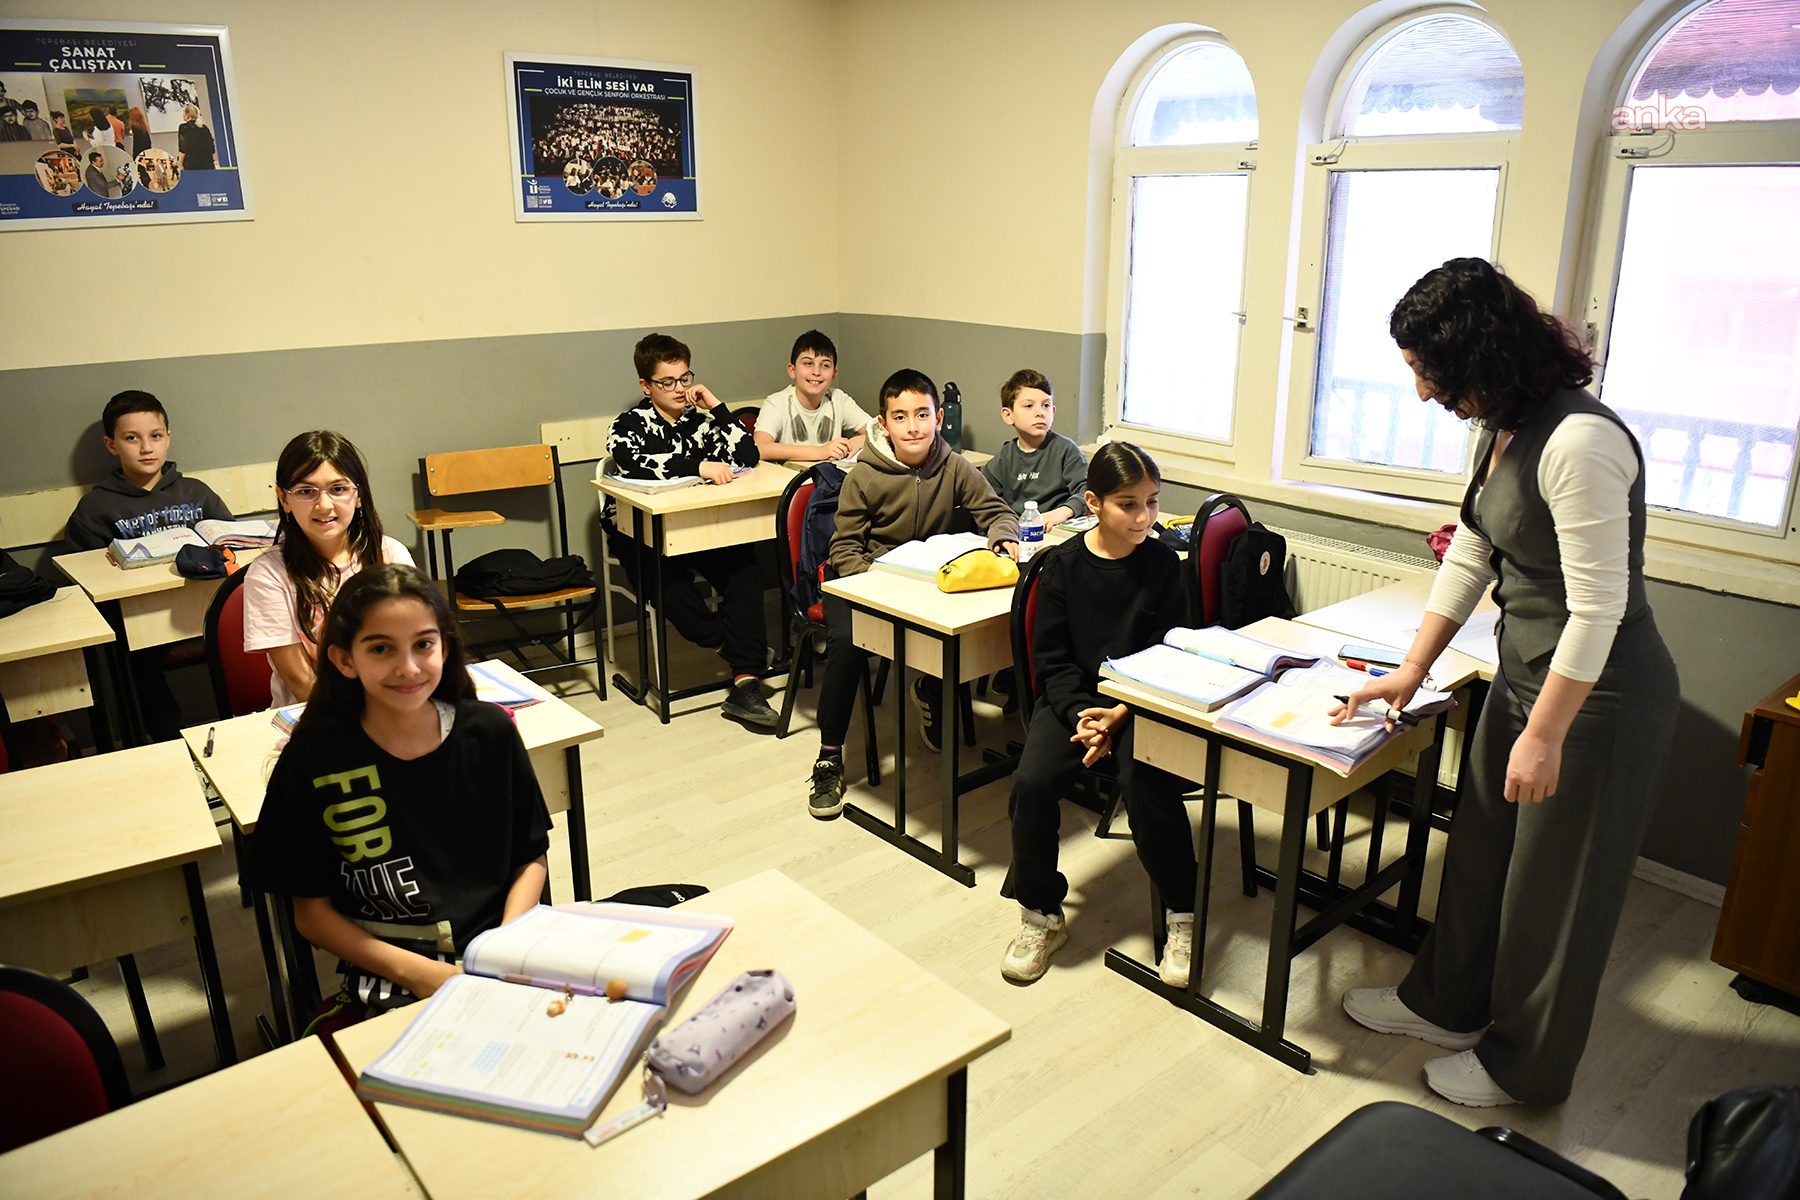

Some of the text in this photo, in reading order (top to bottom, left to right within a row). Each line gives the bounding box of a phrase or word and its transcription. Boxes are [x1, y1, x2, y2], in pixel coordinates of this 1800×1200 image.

[61, 46, 116, 58] SANAT
[48, 58, 133, 73] ÇALIŞTAYI
[557, 75, 655, 93] İKİ ELİN SESİ VAR
[313, 764, 393, 863] FOR
